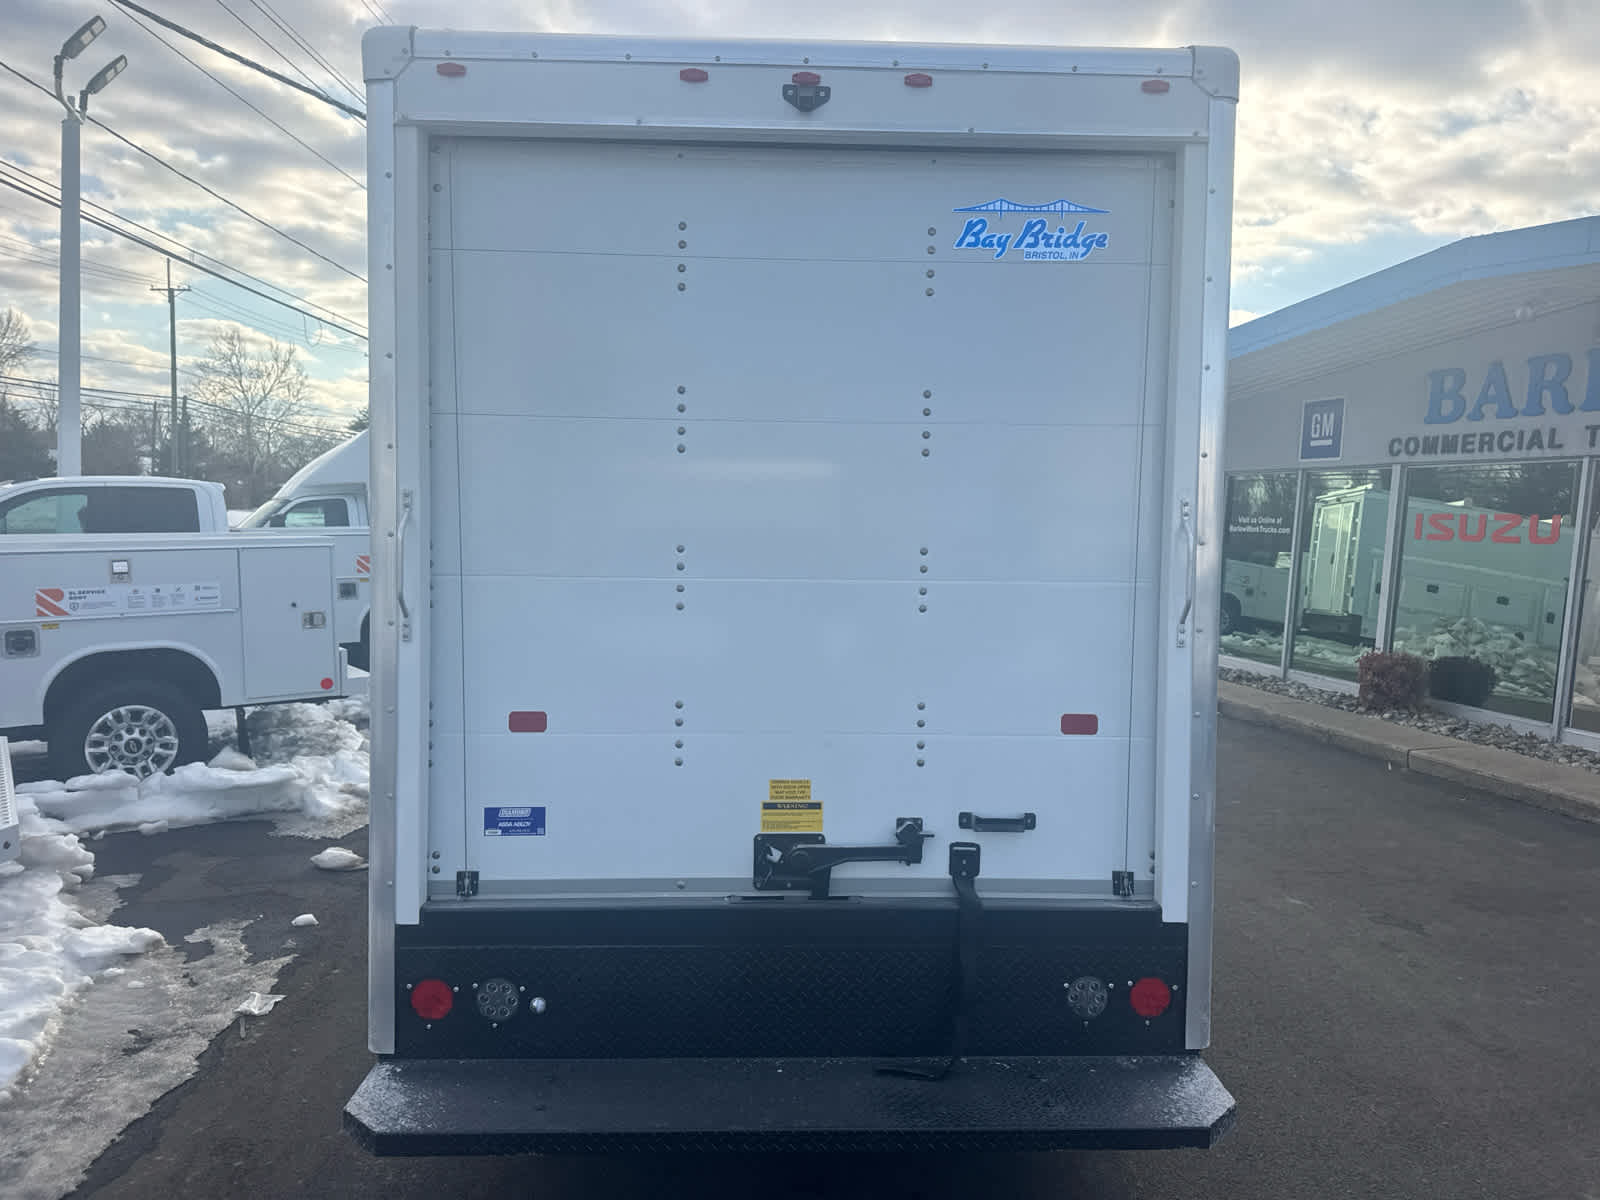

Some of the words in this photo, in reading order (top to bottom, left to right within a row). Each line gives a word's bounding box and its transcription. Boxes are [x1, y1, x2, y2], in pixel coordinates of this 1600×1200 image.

[954, 218, 1013, 259] Bay
[1013, 218, 1109, 259] Bridge
[1024, 251, 1067, 260] BRISTOL,
[1069, 251, 1080, 260] IN
[1311, 412, 1335, 438] GM
[1388, 427, 1564, 457] COMMERCIAL
[1414, 512, 1562, 545] ISUZU
